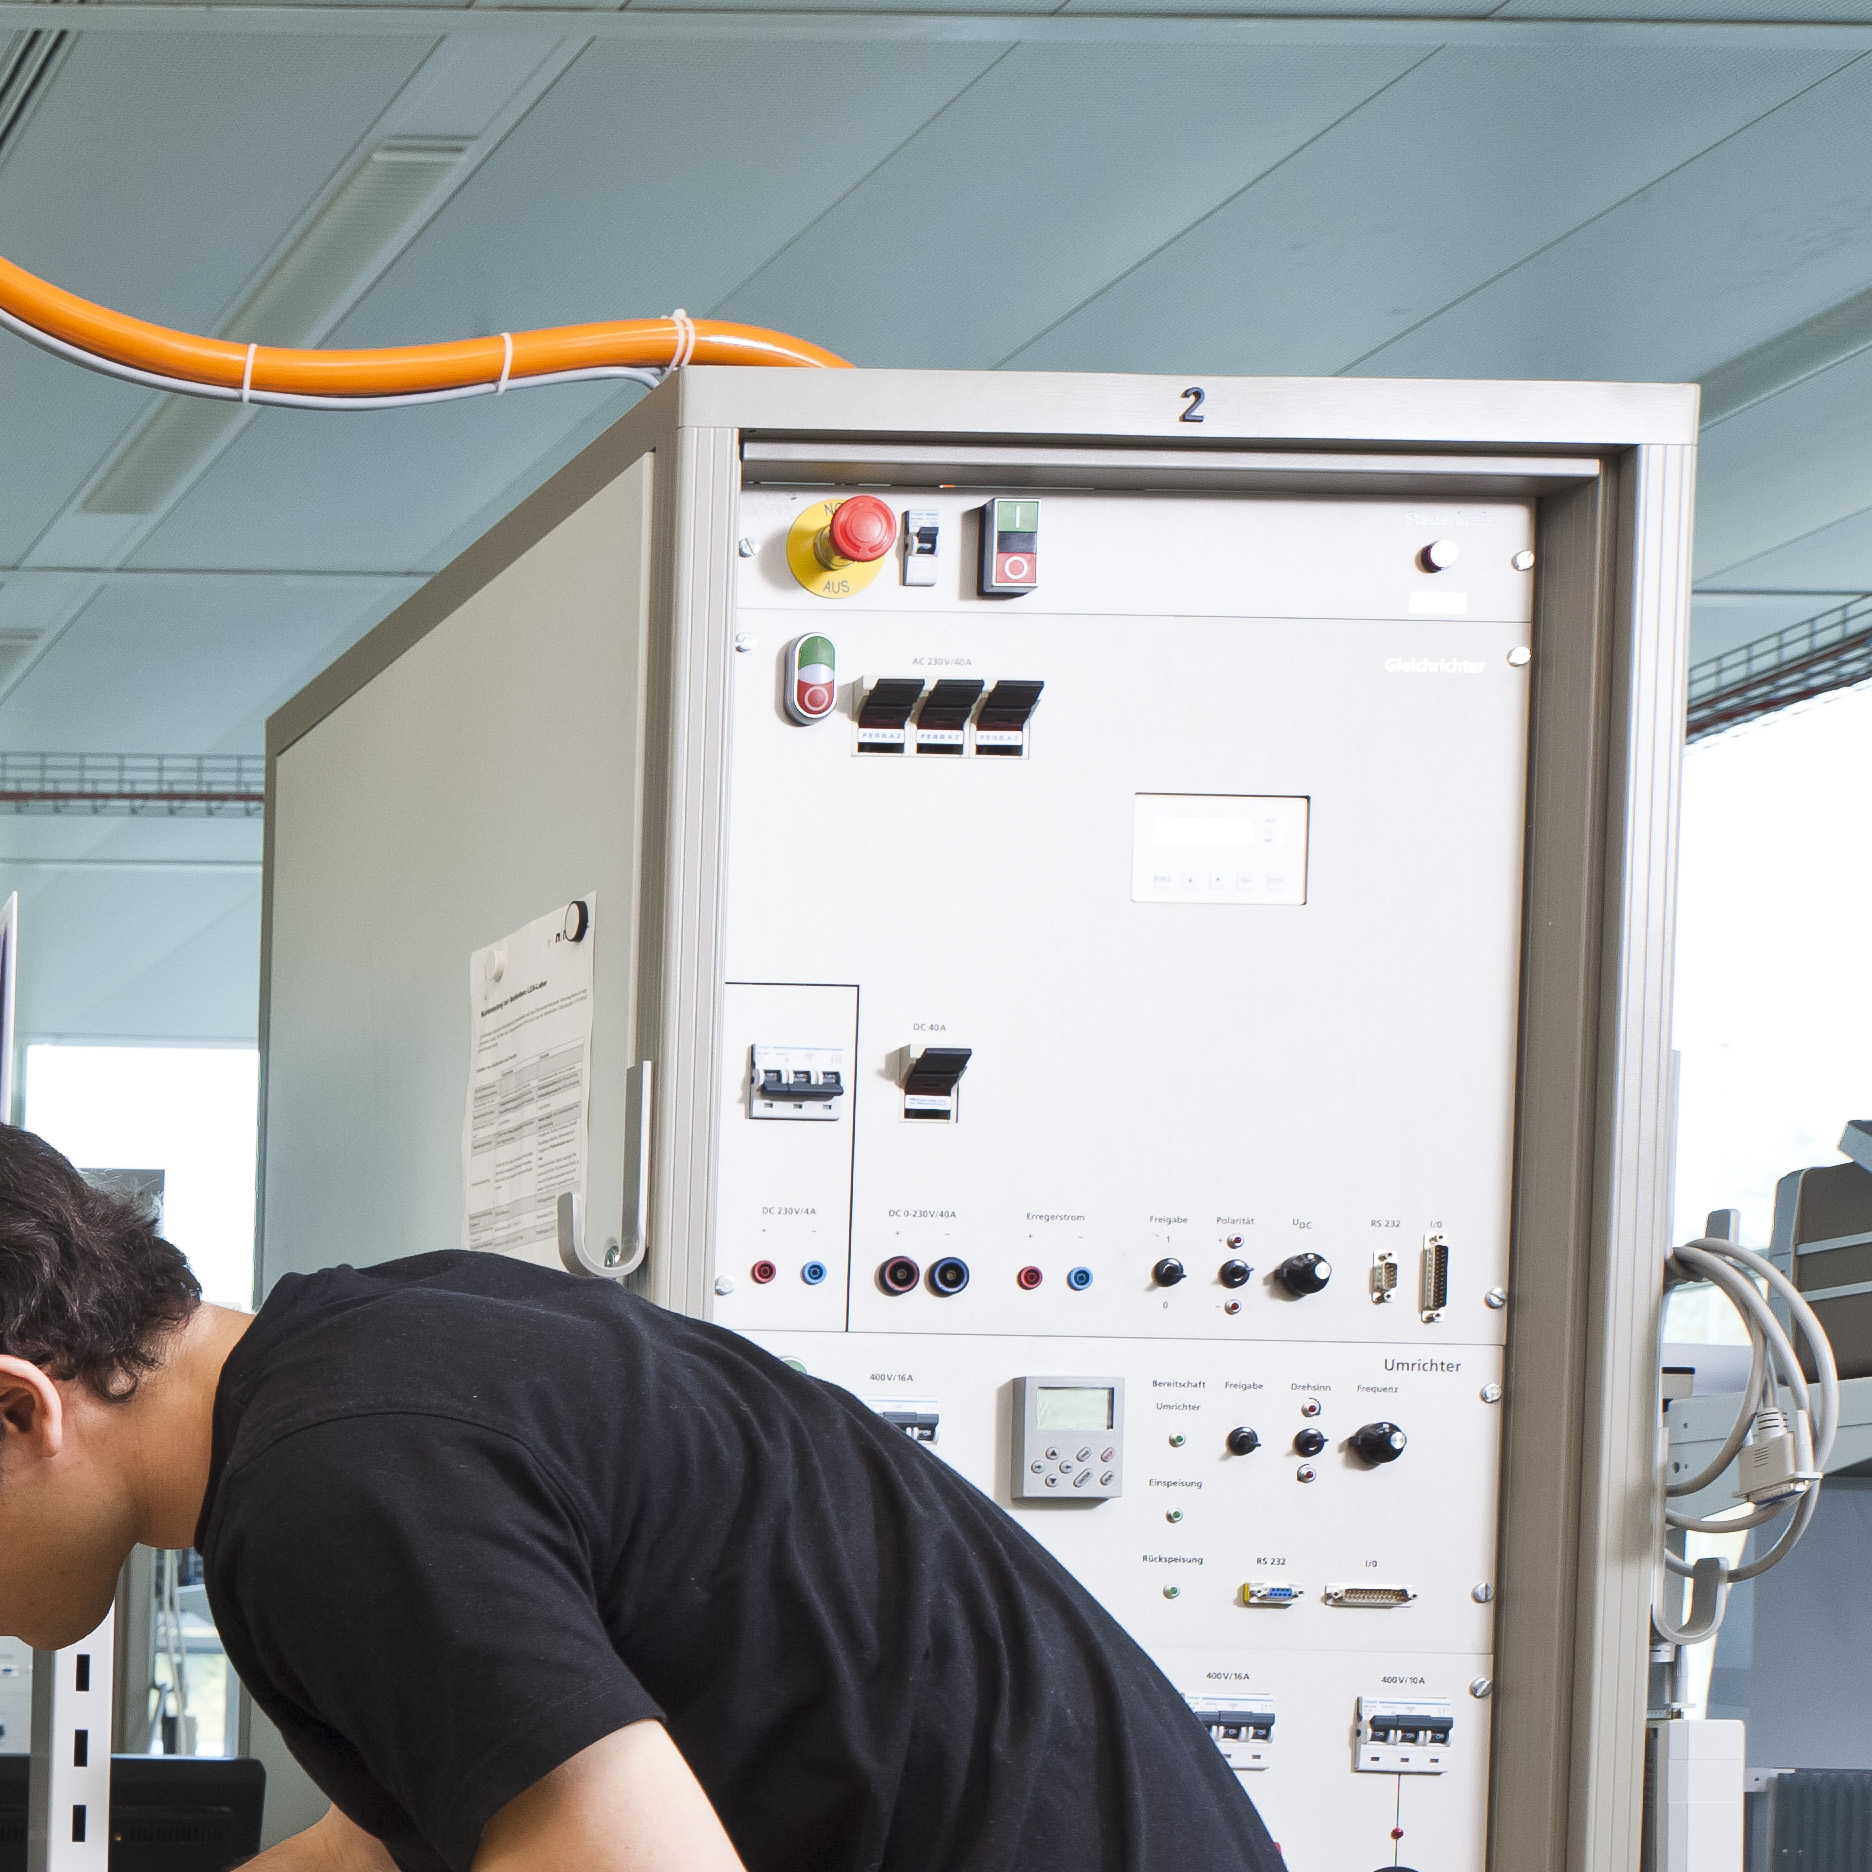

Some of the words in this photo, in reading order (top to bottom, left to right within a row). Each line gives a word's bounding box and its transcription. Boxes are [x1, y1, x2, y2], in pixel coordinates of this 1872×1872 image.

[1179, 387, 1206, 423] 2
[1405, 511, 1493, 527] Steuerkreis
[823, 581, 850, 594] AUS
[912, 657, 925, 666] AC
[1384, 656, 1487, 674] Gleichrichter
[913, 1023, 926, 1032] DC
[928, 1023, 947, 1032] 40A
[761, 1206, 774, 1215] DC
[888, 1209, 902, 1218] DC
[1026, 1212, 1085, 1224] Erregerstrom
[1149, 1215, 1188, 1225] Freigabe
[1216, 1215, 1255, 1225] Polarität
[1370, 1220, 1381, 1228] RS
[1384, 1220, 1401, 1228] 232
[1384, 1358, 1462, 1374] Umrichter
[1152, 1379, 1206, 1389] Bereitschaft
[1224, 1381, 1264, 1391] Freigabe
[1291, 1382, 1332, 1392] Drehsinn
[1357, 1384, 1399, 1394] Frequenz
[1156, 1402, 1201, 1411] Umrichter
[1149, 1478, 1203, 1489] Einspeisung
[1142, 1555, 1204, 1565] Rückspeisung
[1256, 1557, 1269, 1565] RS
[1270, 1557, 1286, 1566] 232
